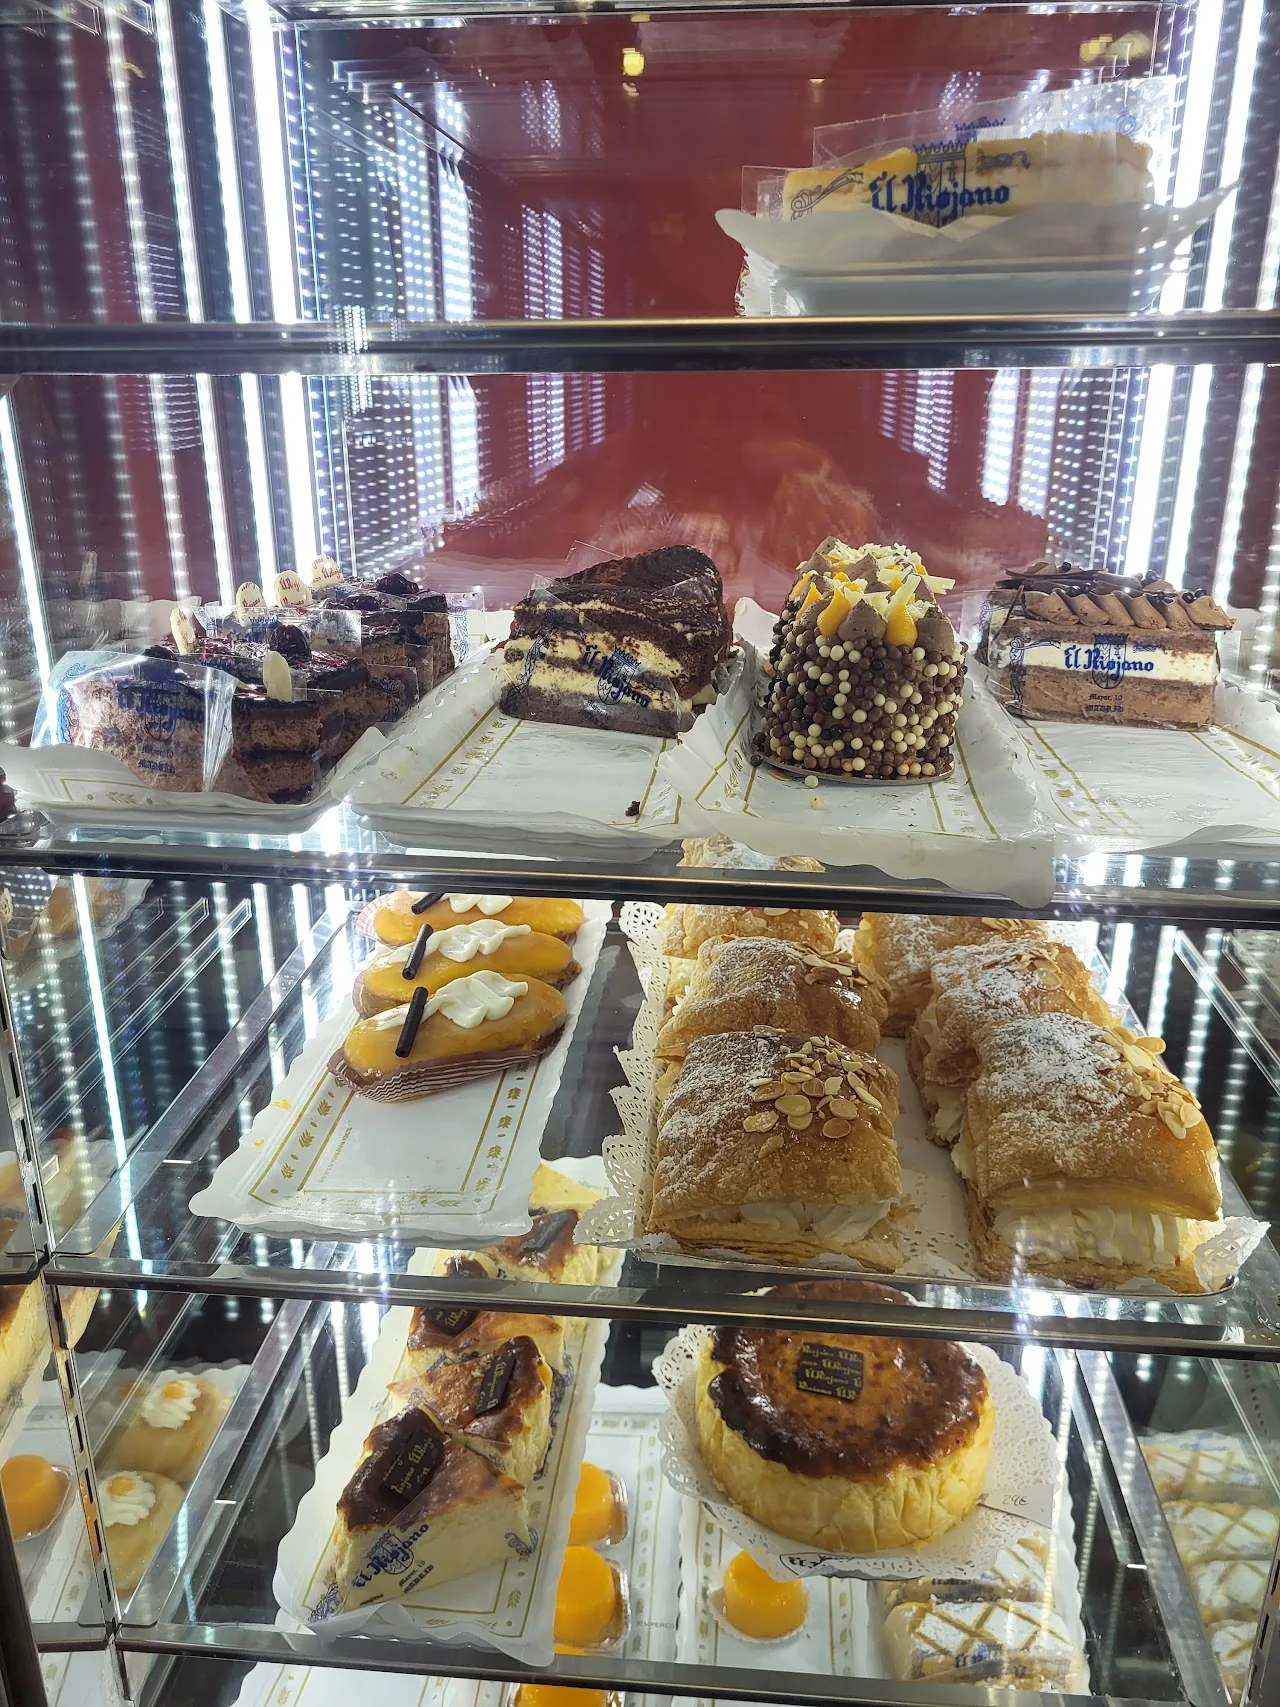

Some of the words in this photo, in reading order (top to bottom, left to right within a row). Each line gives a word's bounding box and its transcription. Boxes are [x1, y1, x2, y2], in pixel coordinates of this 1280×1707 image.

[869, 171, 897, 213] El
[900, 170, 1010, 225] Riojano
[582, 645, 601, 669] El
[1064, 645, 1081, 669] El
[1083, 647, 1154, 681] Riojano
[366, 1524, 430, 1575] Riojano
